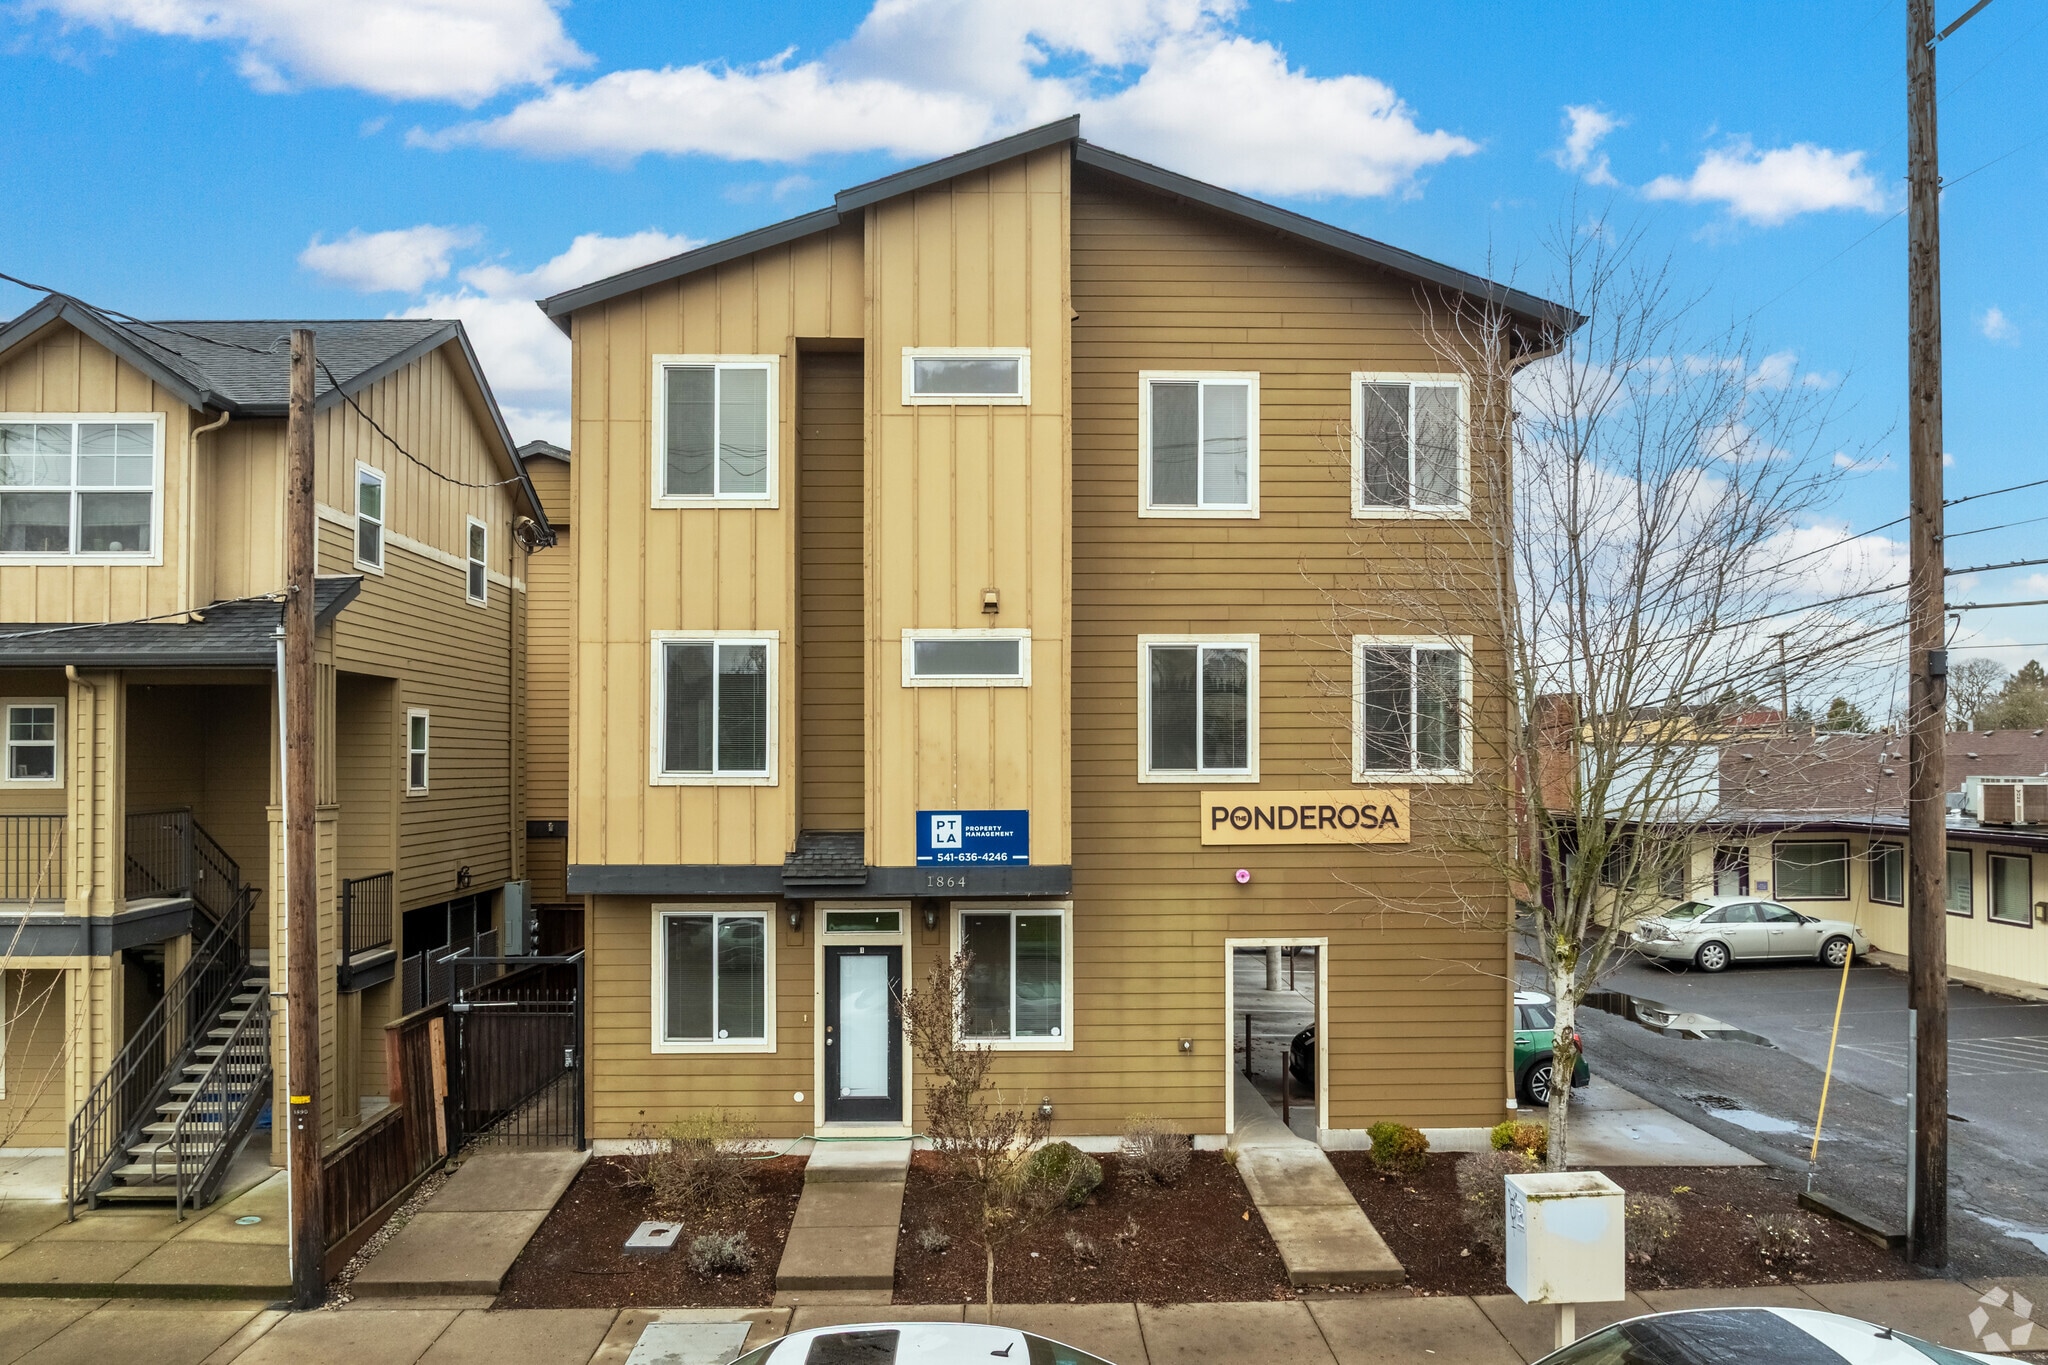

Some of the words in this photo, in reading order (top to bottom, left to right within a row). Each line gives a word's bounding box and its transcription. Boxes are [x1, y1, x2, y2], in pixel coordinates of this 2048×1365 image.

[1211, 804, 1400, 831] PONDEROSA
[937, 852, 1008, 862] 541-636-4246
[927, 876, 966, 888] 1864
